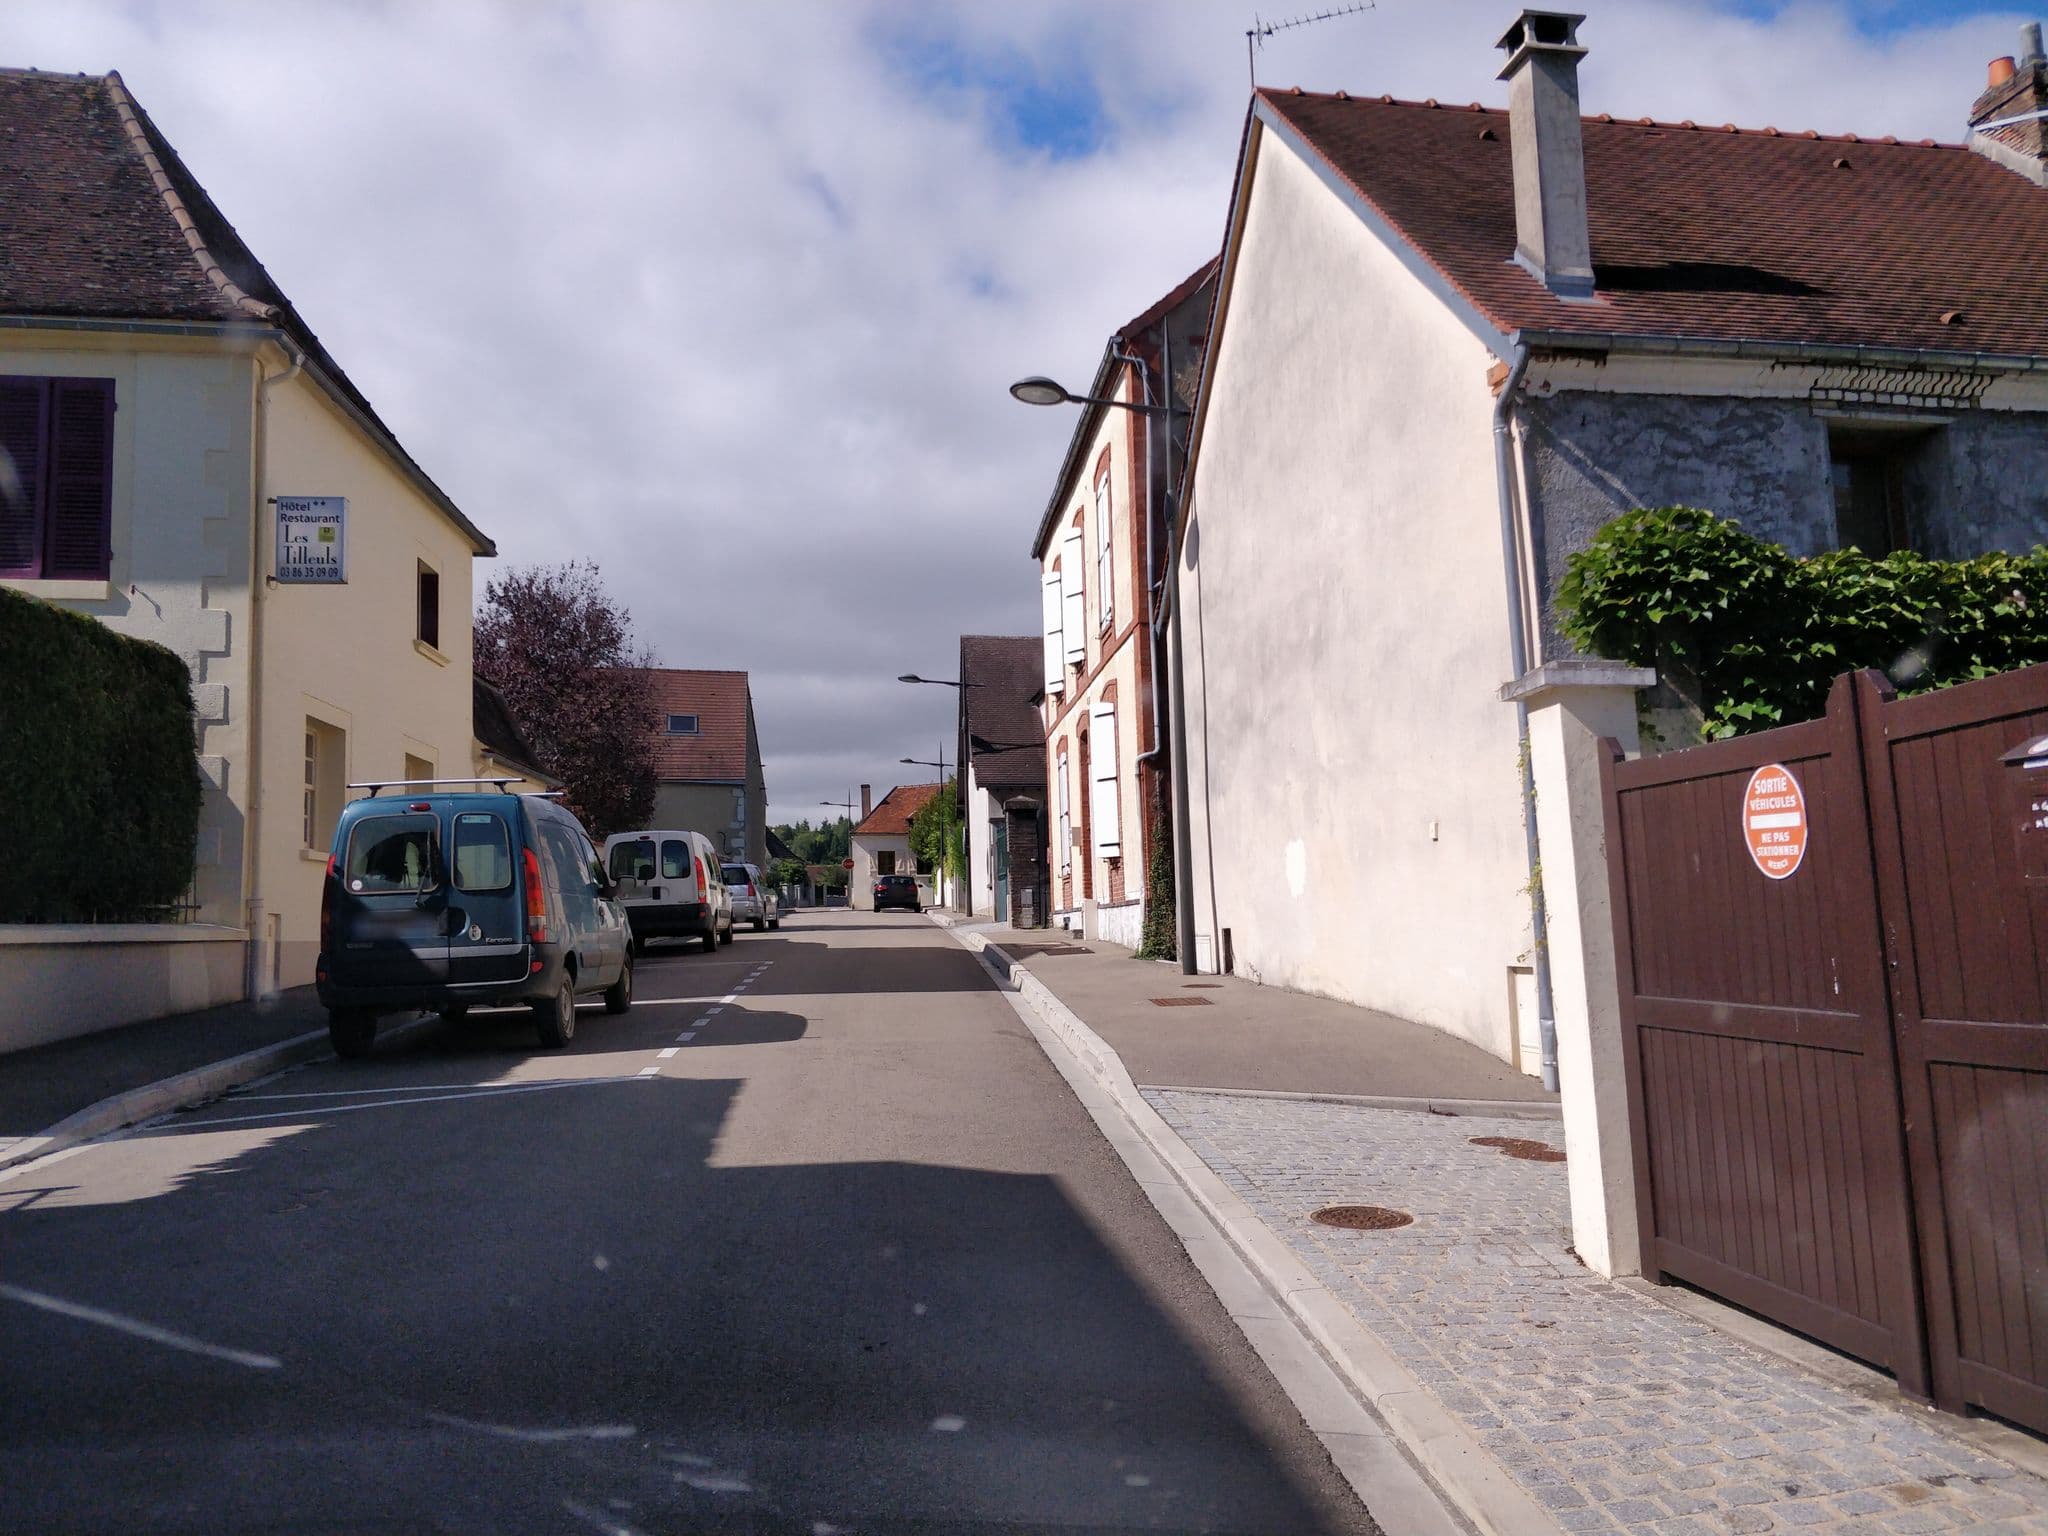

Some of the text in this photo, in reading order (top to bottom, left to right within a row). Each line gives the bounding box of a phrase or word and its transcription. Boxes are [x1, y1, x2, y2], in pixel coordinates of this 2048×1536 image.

[280, 502, 310, 511] Hôtel
[280, 513, 340, 523] Restaurant
[284, 525, 309, 543] Les
[283, 545, 337, 564] Tilleuls
[280, 567, 290, 577] 03
[292, 567, 302, 577] 86
[304, 567, 314, 577] 35
[328, 567, 338, 577] 09
[1755, 776, 1787, 794] SORTIE
[1761, 832, 1790, 843] NE PAS
